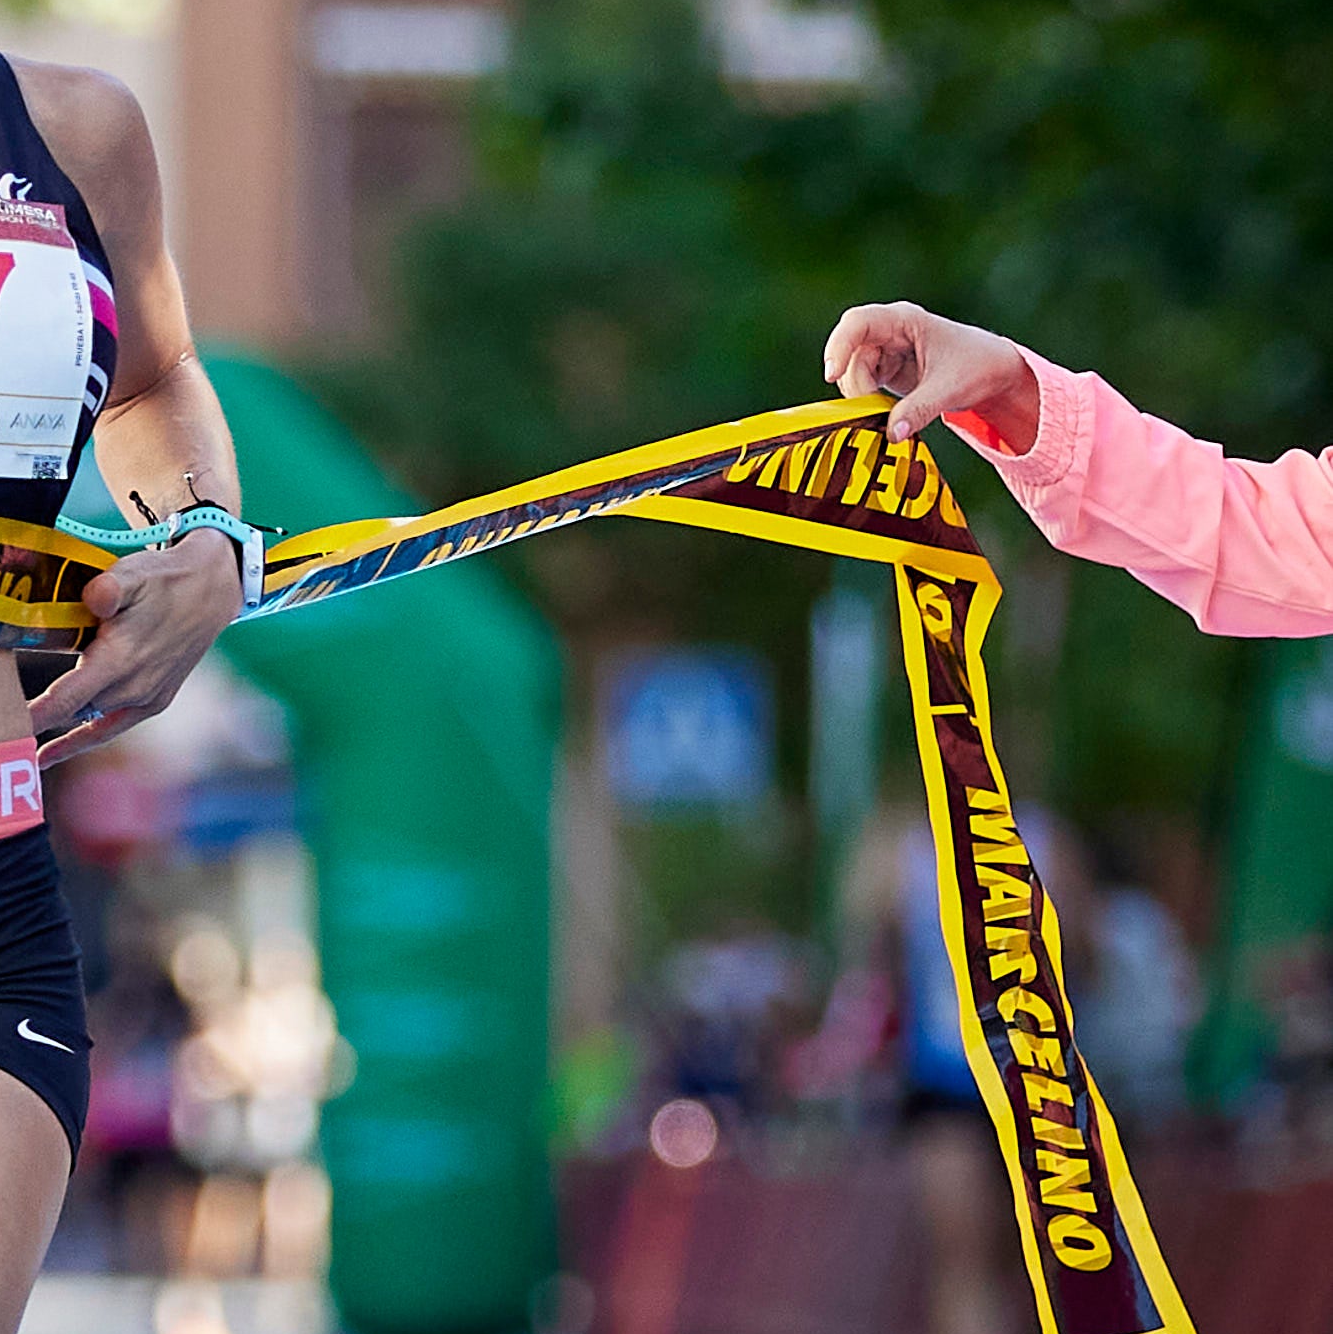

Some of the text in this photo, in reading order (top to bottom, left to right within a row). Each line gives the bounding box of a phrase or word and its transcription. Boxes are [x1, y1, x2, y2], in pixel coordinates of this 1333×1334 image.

[75, 329, 84, 366] PRUEBA
[10, 412, 67, 429] ANAYA
[965, 786, 1113, 1273] MARCELINO
